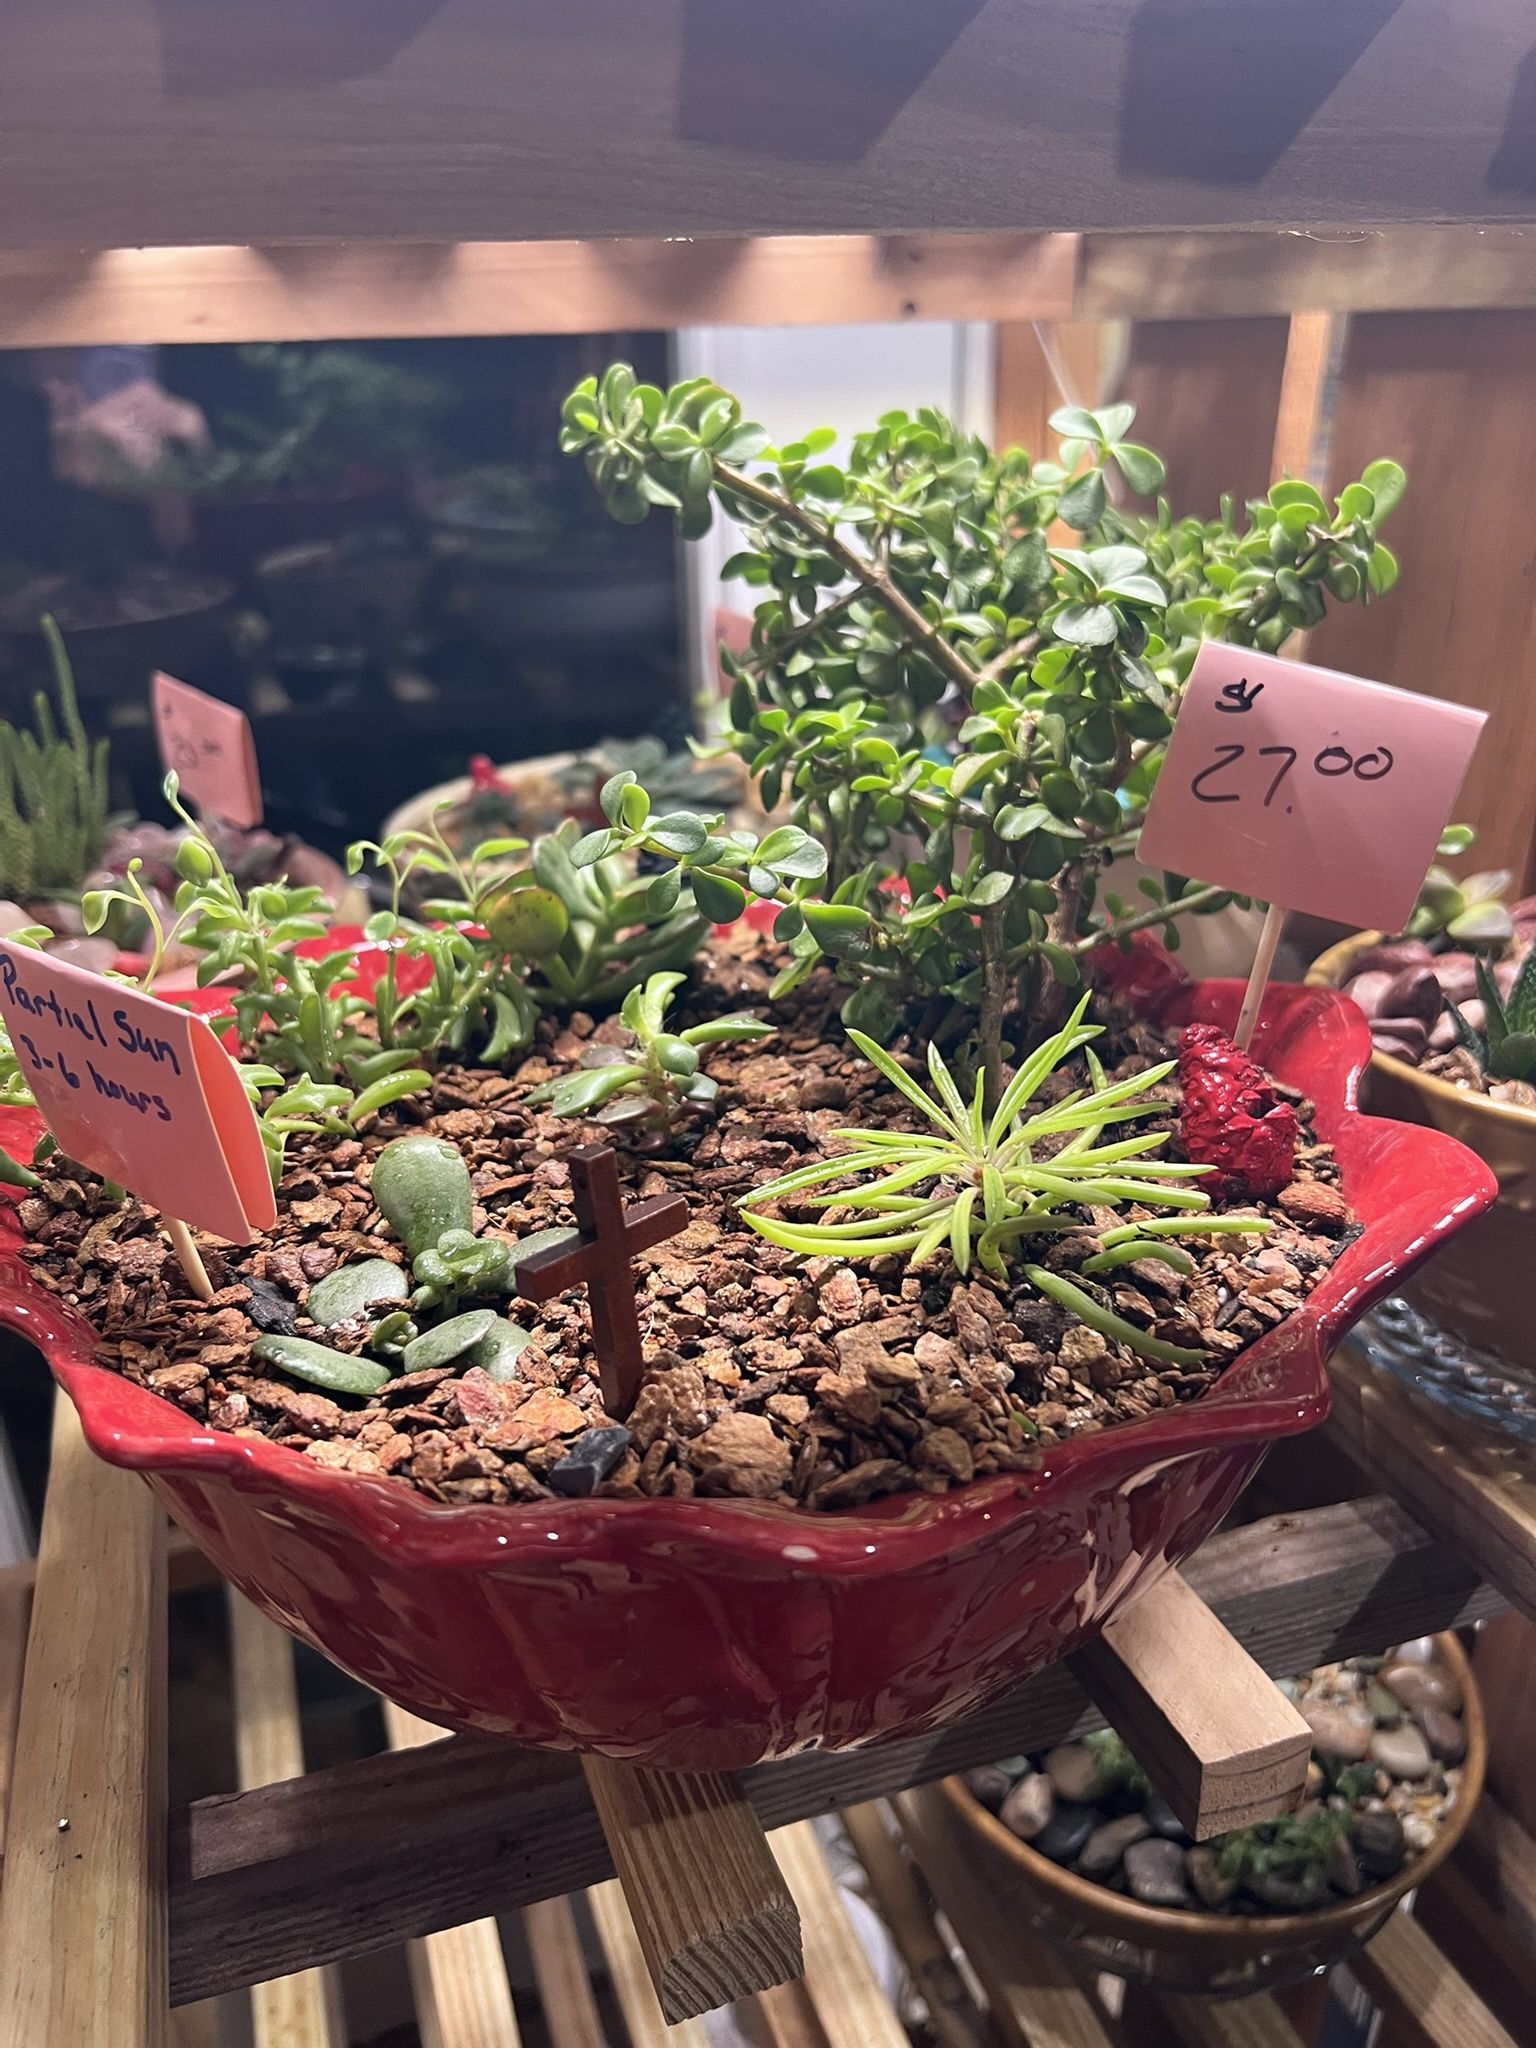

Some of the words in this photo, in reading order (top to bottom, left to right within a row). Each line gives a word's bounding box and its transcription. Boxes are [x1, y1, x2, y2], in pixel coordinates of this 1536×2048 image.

[1191, 744, 1394, 815] 27.00
[0, 953, 107, 1047] Partial
[113, 1010, 181, 1076] Sun
[19, 1033, 81, 1089] 3-6
[86, 1060, 172, 1121] hours
